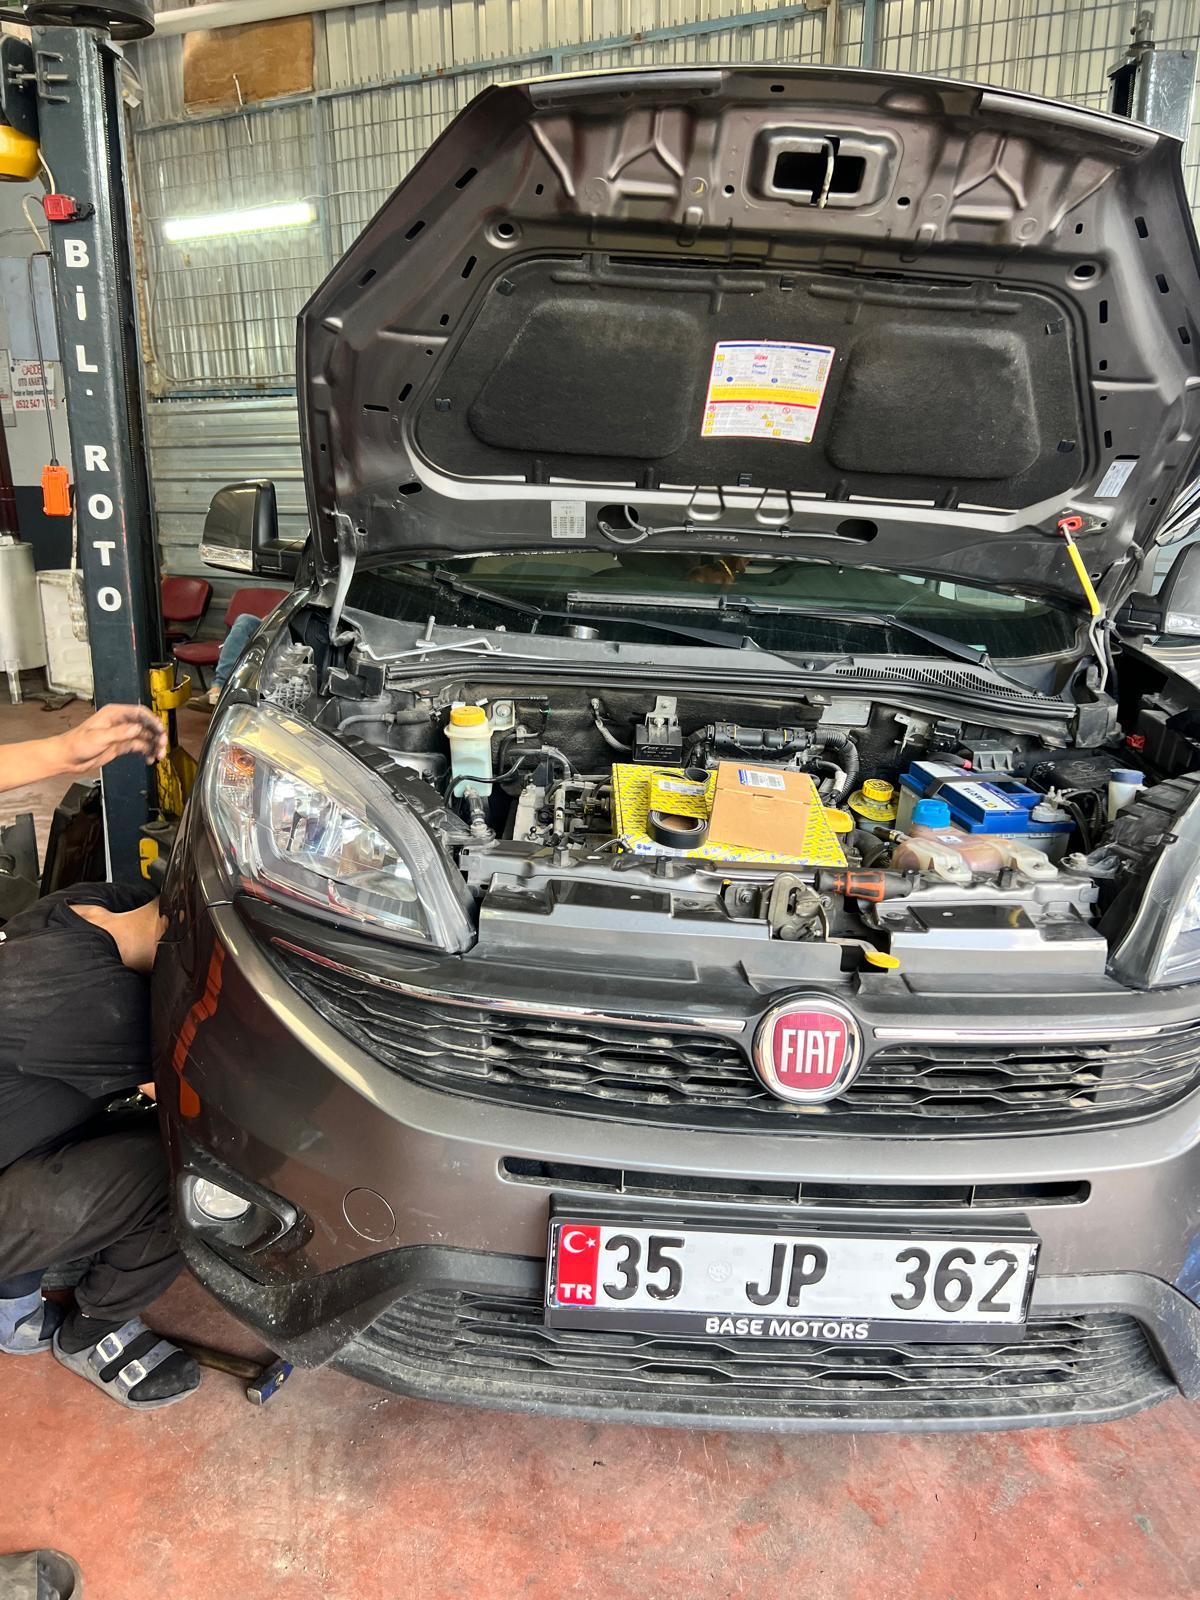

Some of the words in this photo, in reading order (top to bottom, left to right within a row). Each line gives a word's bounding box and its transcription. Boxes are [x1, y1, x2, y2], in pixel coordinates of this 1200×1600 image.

[84, 445, 122, 612] ROTO
[780, 1028, 842, 1074] FIAT
[560, 1283, 593, 1300] TR
[602, 1234, 686, 1301] 35
[745, 1243, 829, 1308] JP
[890, 1246, 1019, 1313] 362
[705, 1317, 765, 1336] BASE
[768, 1320, 870, 1340] MOTORS
